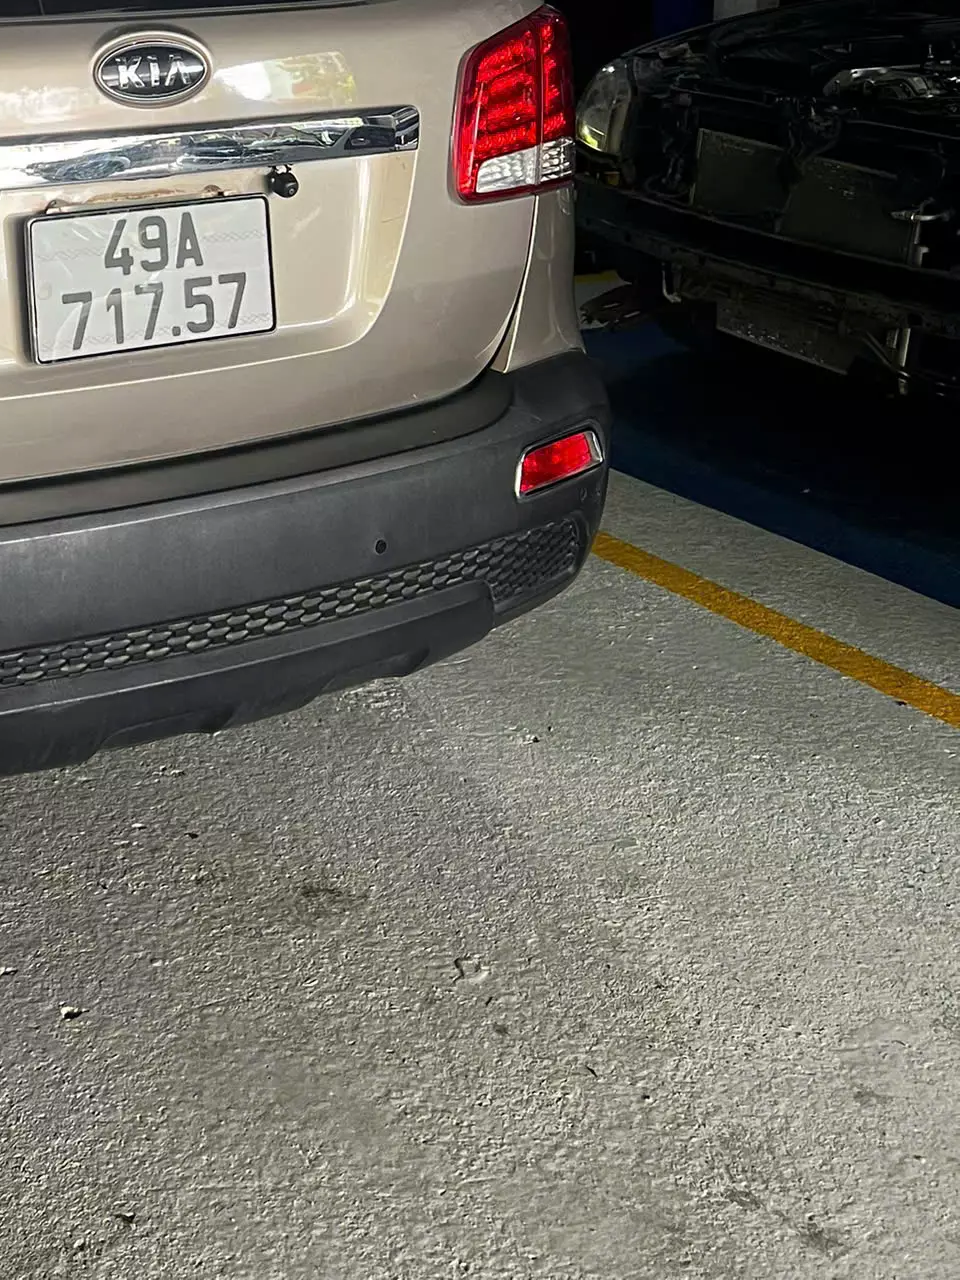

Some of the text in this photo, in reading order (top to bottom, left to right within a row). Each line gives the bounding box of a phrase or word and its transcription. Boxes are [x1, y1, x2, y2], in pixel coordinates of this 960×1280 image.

[115, 54, 193, 89] KIA
[105, 212, 203, 275] 49A
[62, 272, 246, 350] 717.57
